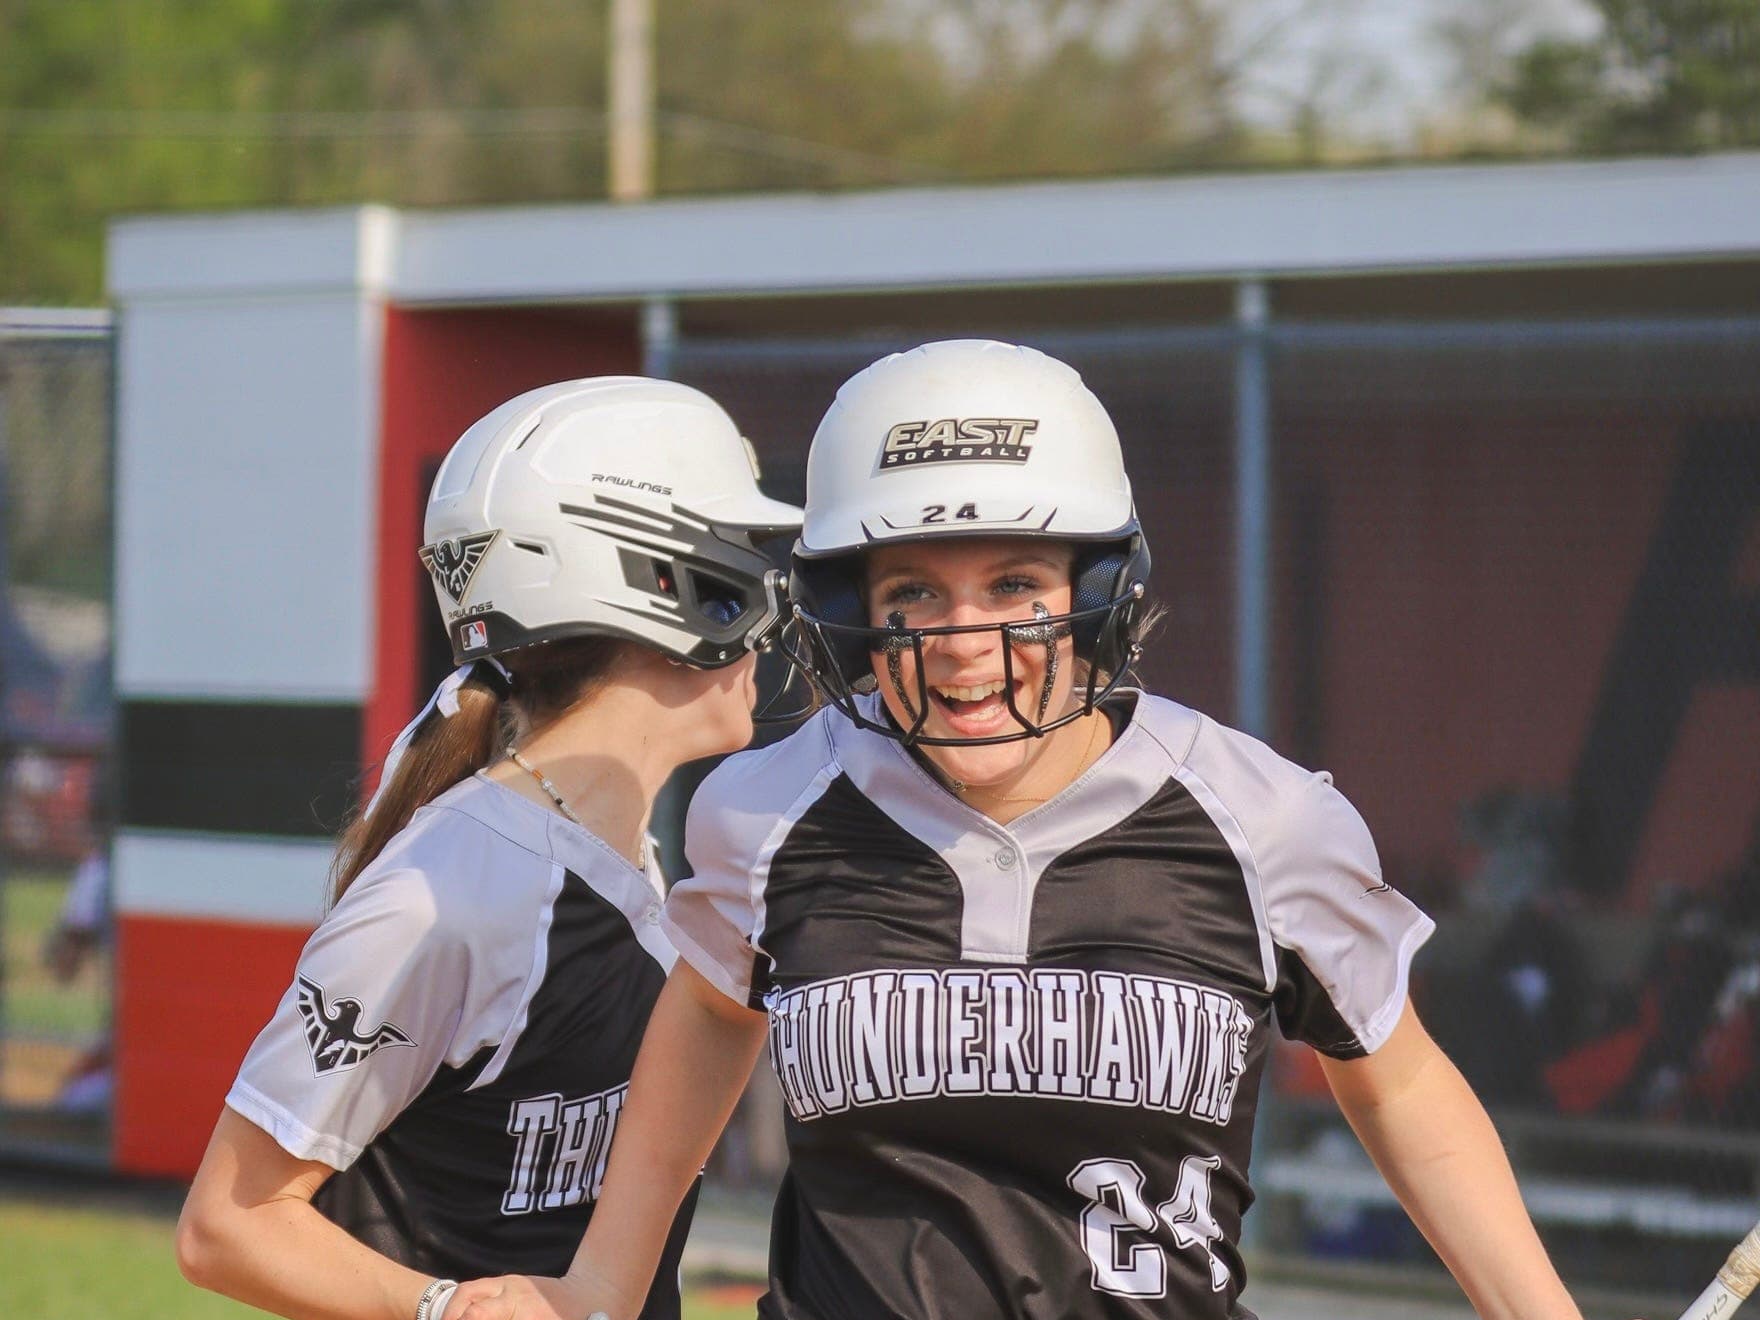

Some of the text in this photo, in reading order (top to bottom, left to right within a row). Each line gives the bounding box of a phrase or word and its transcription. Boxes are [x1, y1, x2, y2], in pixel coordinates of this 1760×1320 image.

[884, 418, 1039, 453] EAST
[887, 447, 1026, 463] SOFTBALL
[591, 473, 673, 497] RAWLINGS
[921, 502, 979, 524] 24
[1066, 1155, 1231, 1299] 24
